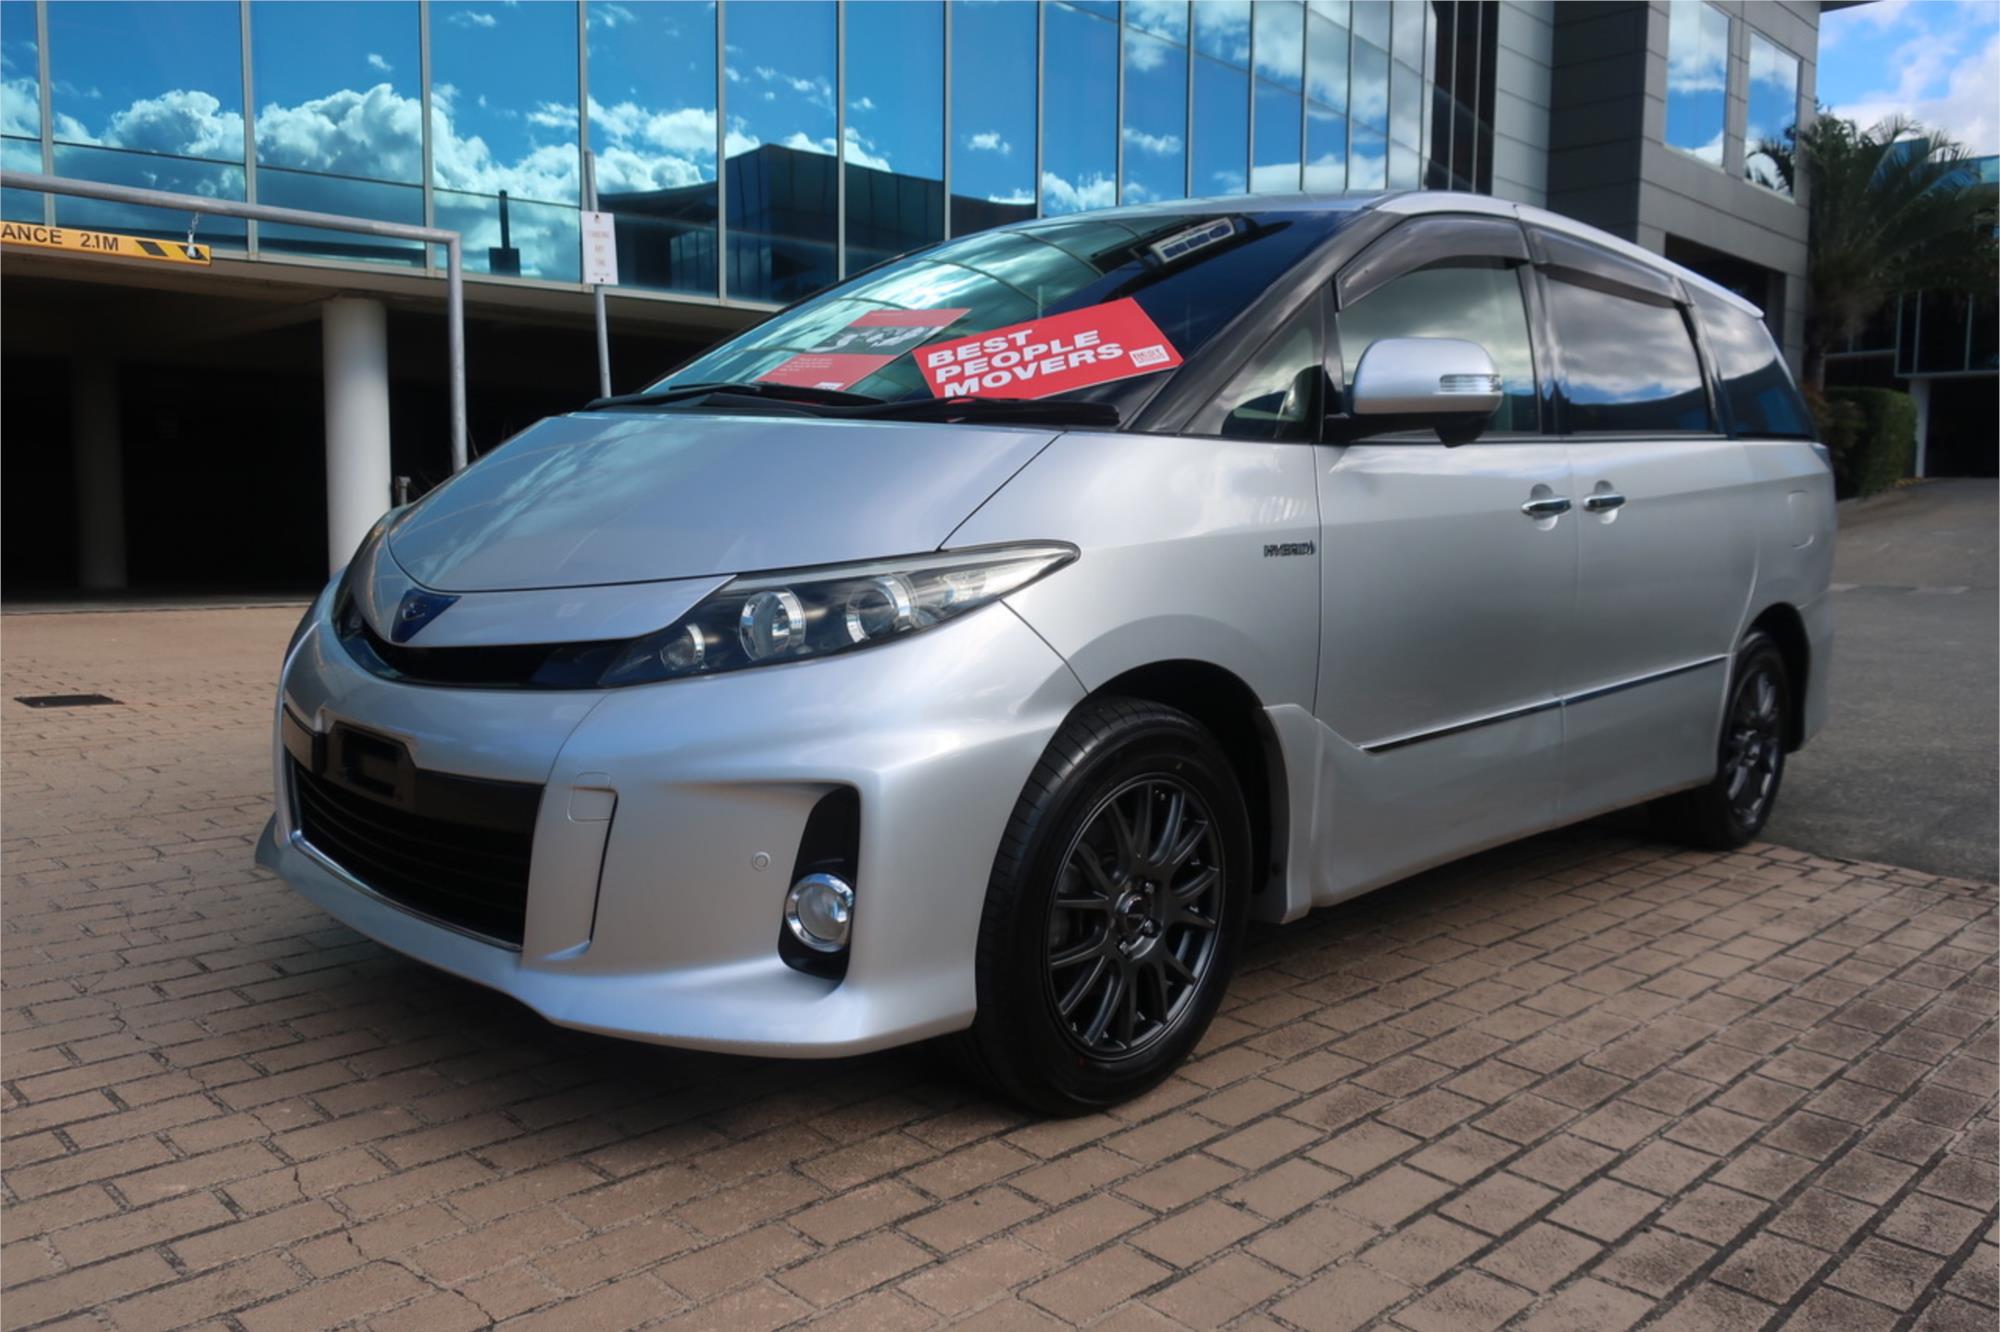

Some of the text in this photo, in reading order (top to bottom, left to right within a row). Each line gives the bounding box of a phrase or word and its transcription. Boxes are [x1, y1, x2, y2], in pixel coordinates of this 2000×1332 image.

[1, 223, 119, 251] ANCE 2.1M
[927, 329, 1033, 368] BEST
[936, 330, 1100, 384] PEOPLE
[944, 343, 1124, 398] MOVERS
[1263, 542, 1313, 558] HYBRID
